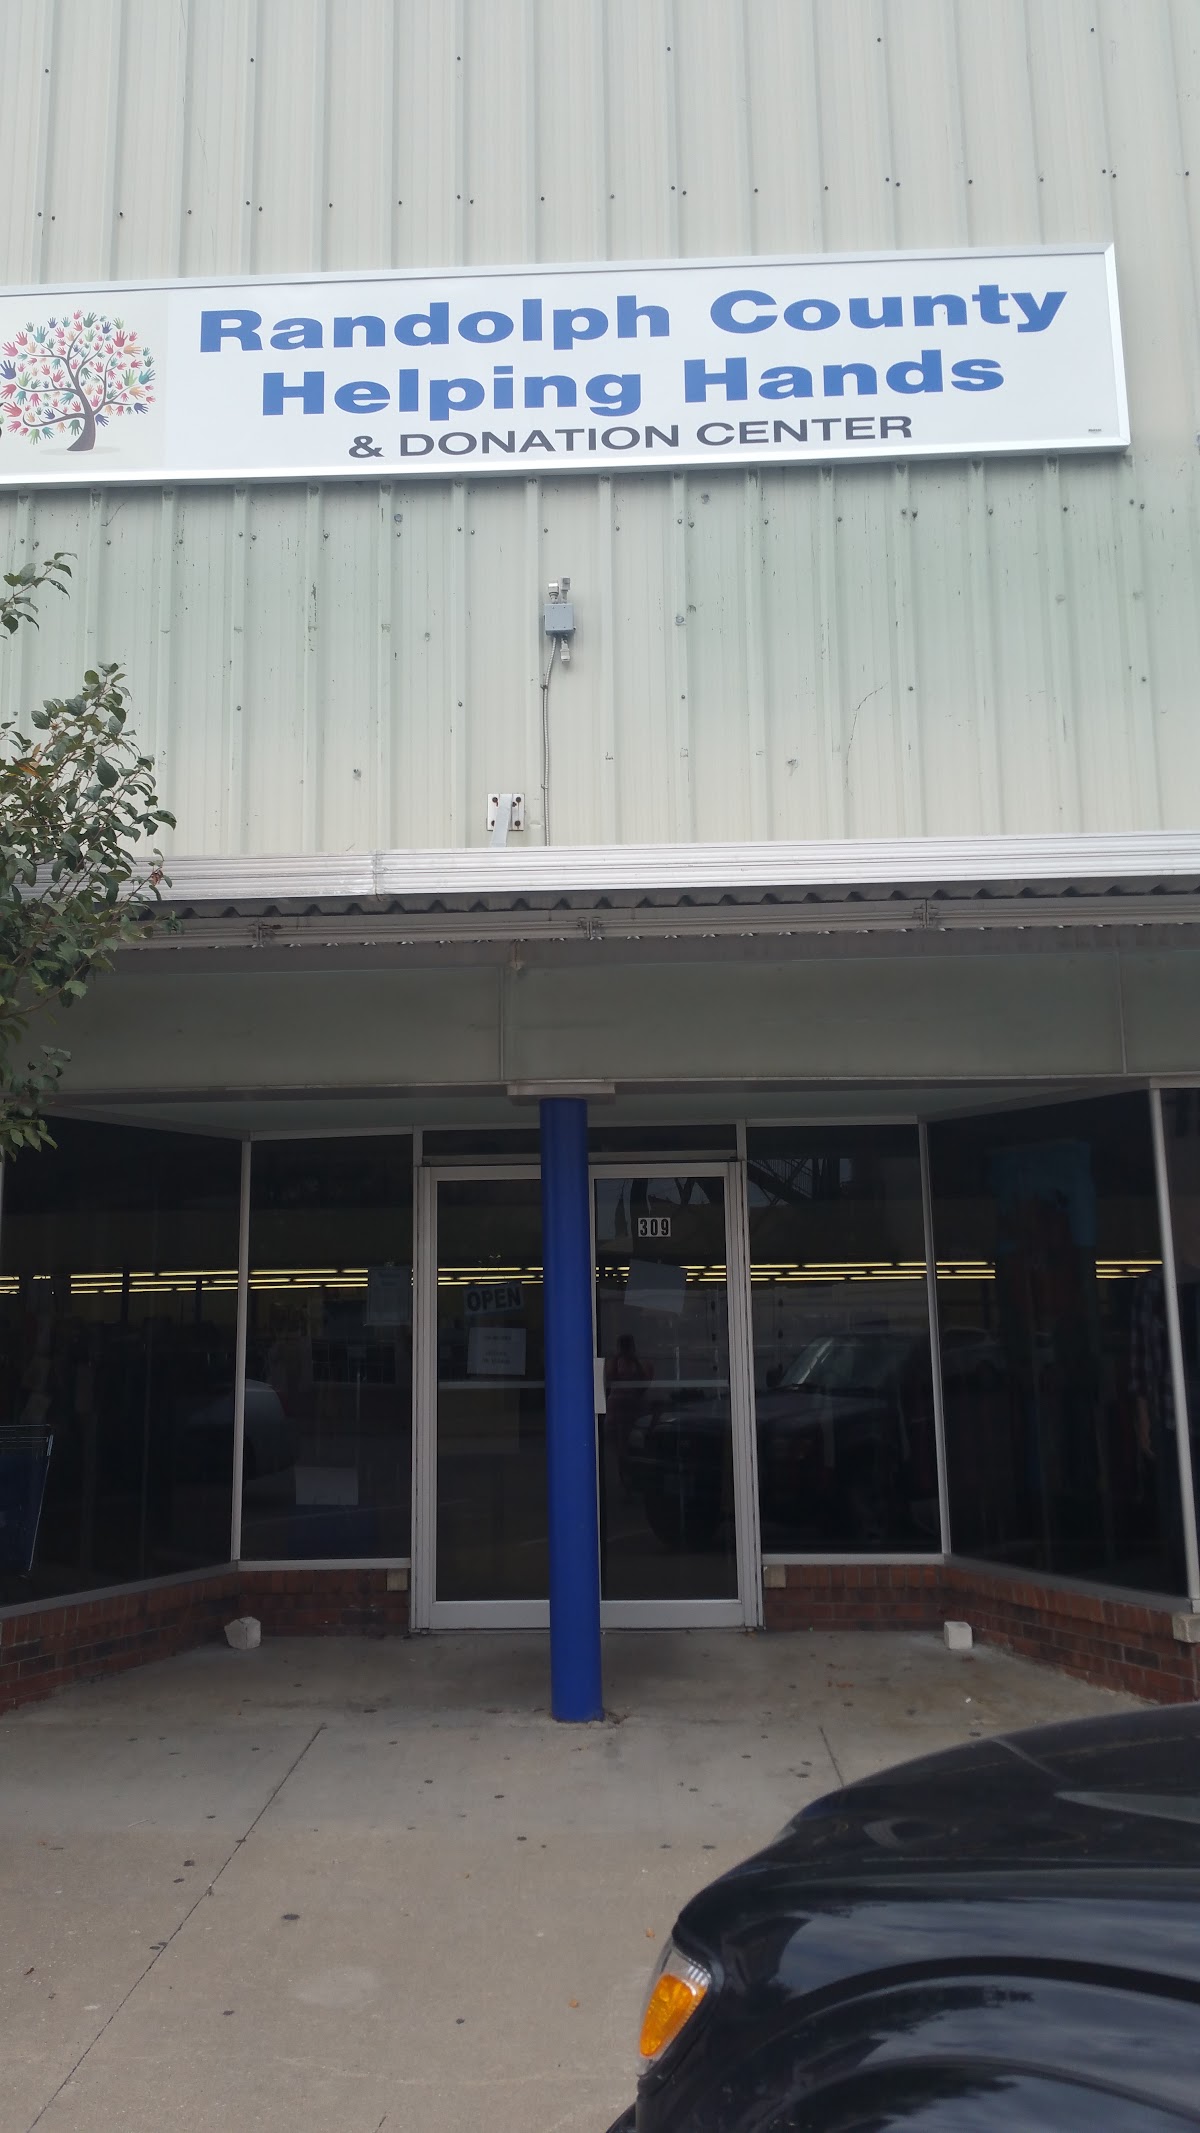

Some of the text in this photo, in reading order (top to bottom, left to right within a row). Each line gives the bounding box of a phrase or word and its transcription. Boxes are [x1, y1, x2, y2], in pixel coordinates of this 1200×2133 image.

[200, 284, 1068, 353] Randolph County
[262, 349, 1005, 421] Helping Hands
[348, 416, 912, 458] & DONATION CENTER
[639, 1218, 670, 1236] 309
[466, 1287, 521, 1312] OPEN
